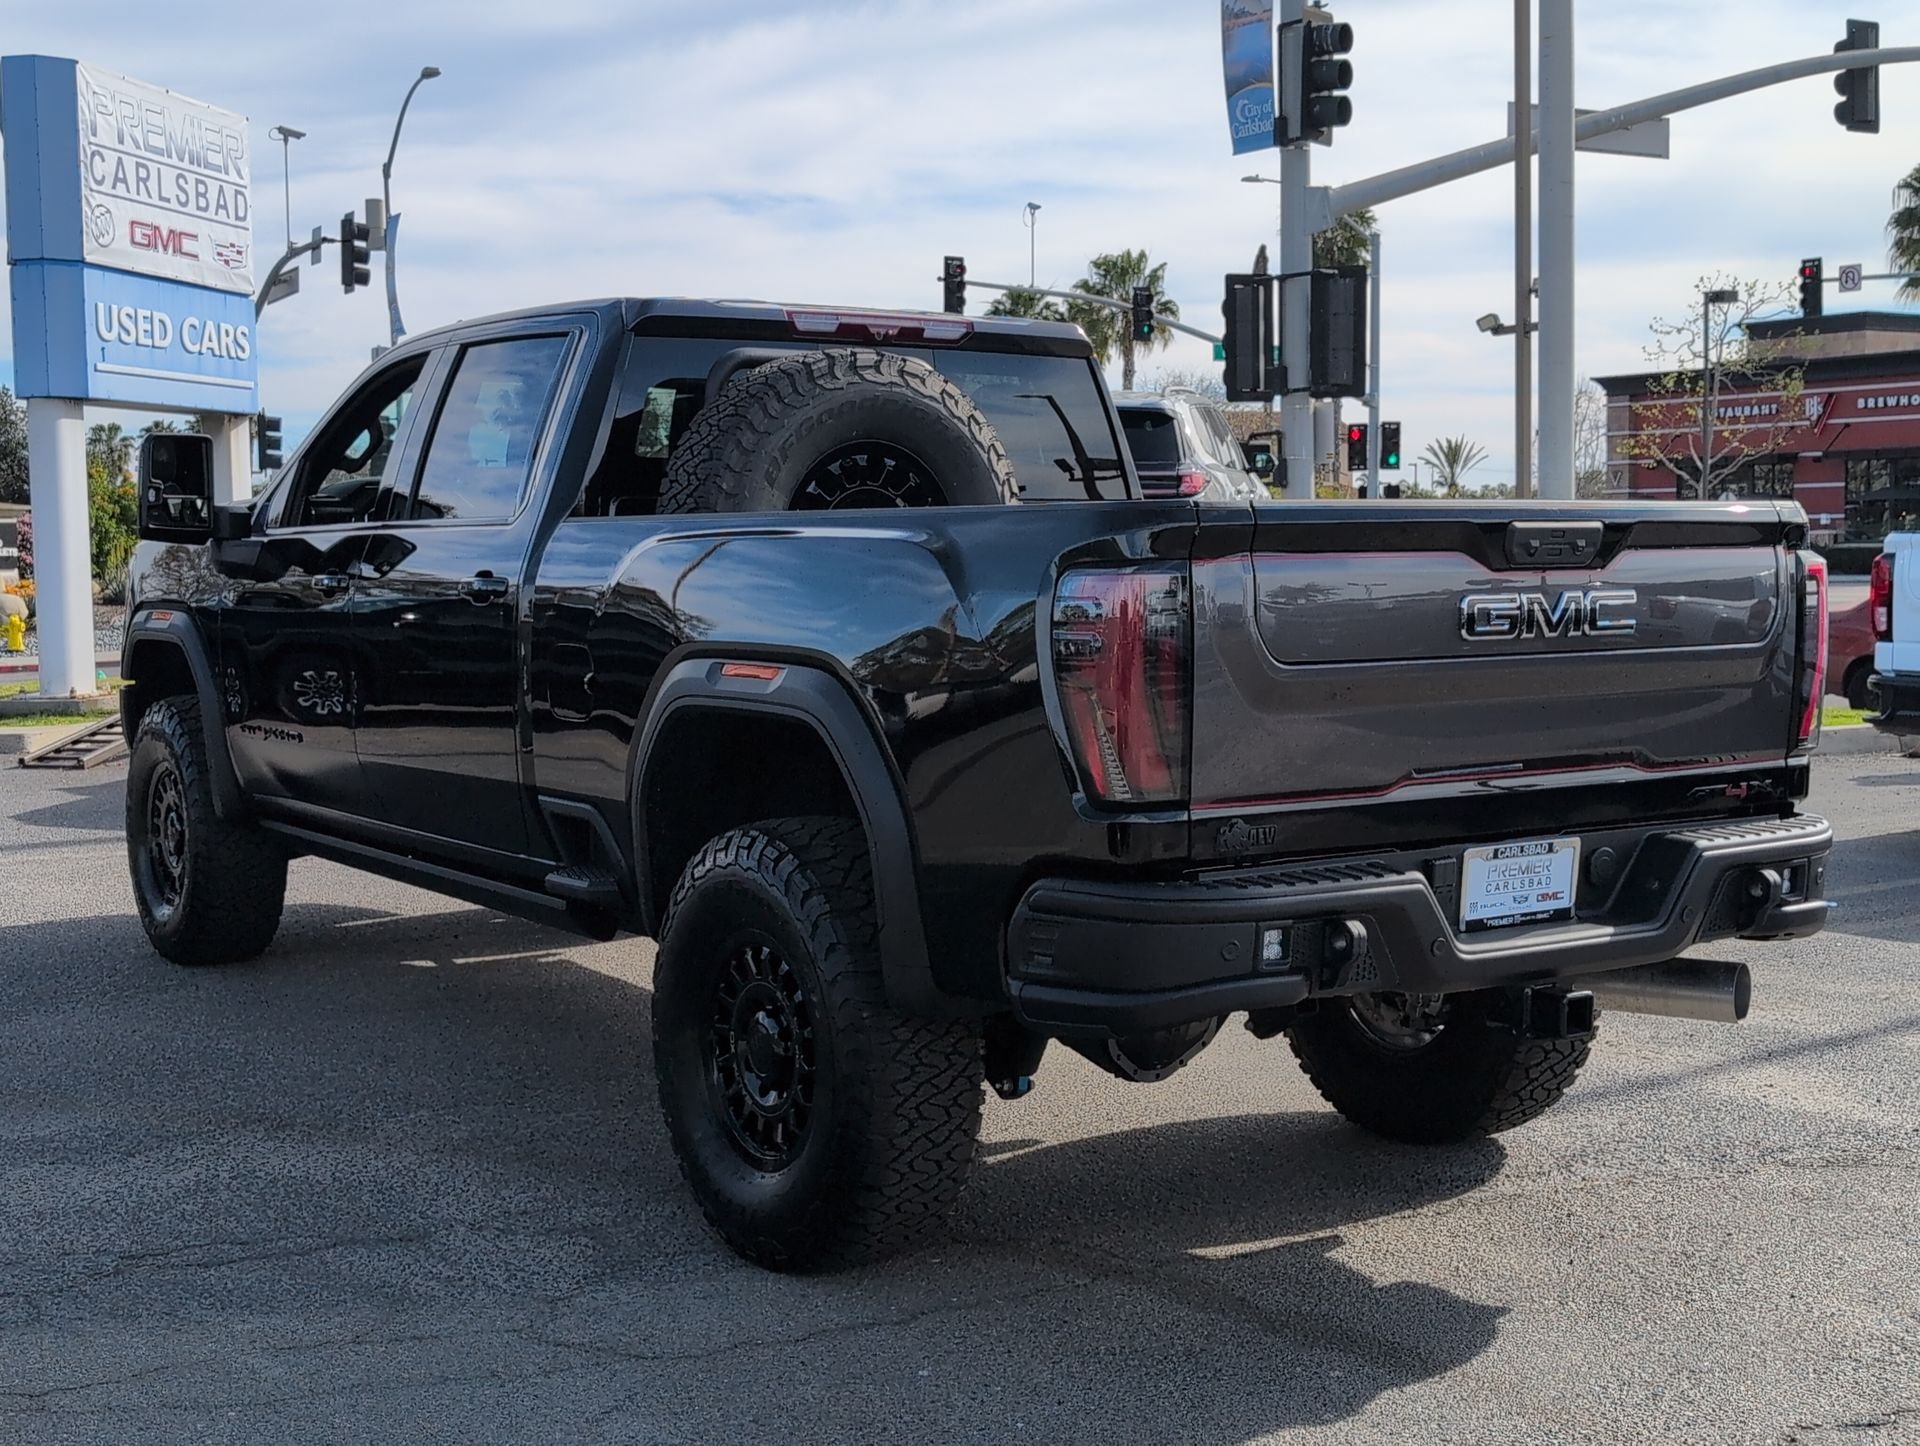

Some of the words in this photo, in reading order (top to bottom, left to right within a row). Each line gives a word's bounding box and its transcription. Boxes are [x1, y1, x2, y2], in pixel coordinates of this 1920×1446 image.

[1263, 99, 1272, 113] of
[87, 85, 246, 180] PREMIER
[1232, 113, 1274, 139] Carlsbad
[88, 149, 248, 223] CARLSBAD
[128, 219, 199, 261] GMC
[95, 302, 173, 349] USED
[180, 316, 250, 361] CARS
[1459, 589, 1638, 641] GMC
[1249, 827, 1275, 847] AEV
[1498, 844, 1548, 858] CARLSBAD
[1487, 858, 1552, 880] PREMIER
[1485, 877, 1551, 893] CARLSBAD
[1536, 891, 1564, 902] GMC
[1487, 917, 1514, 927] PREMIER
